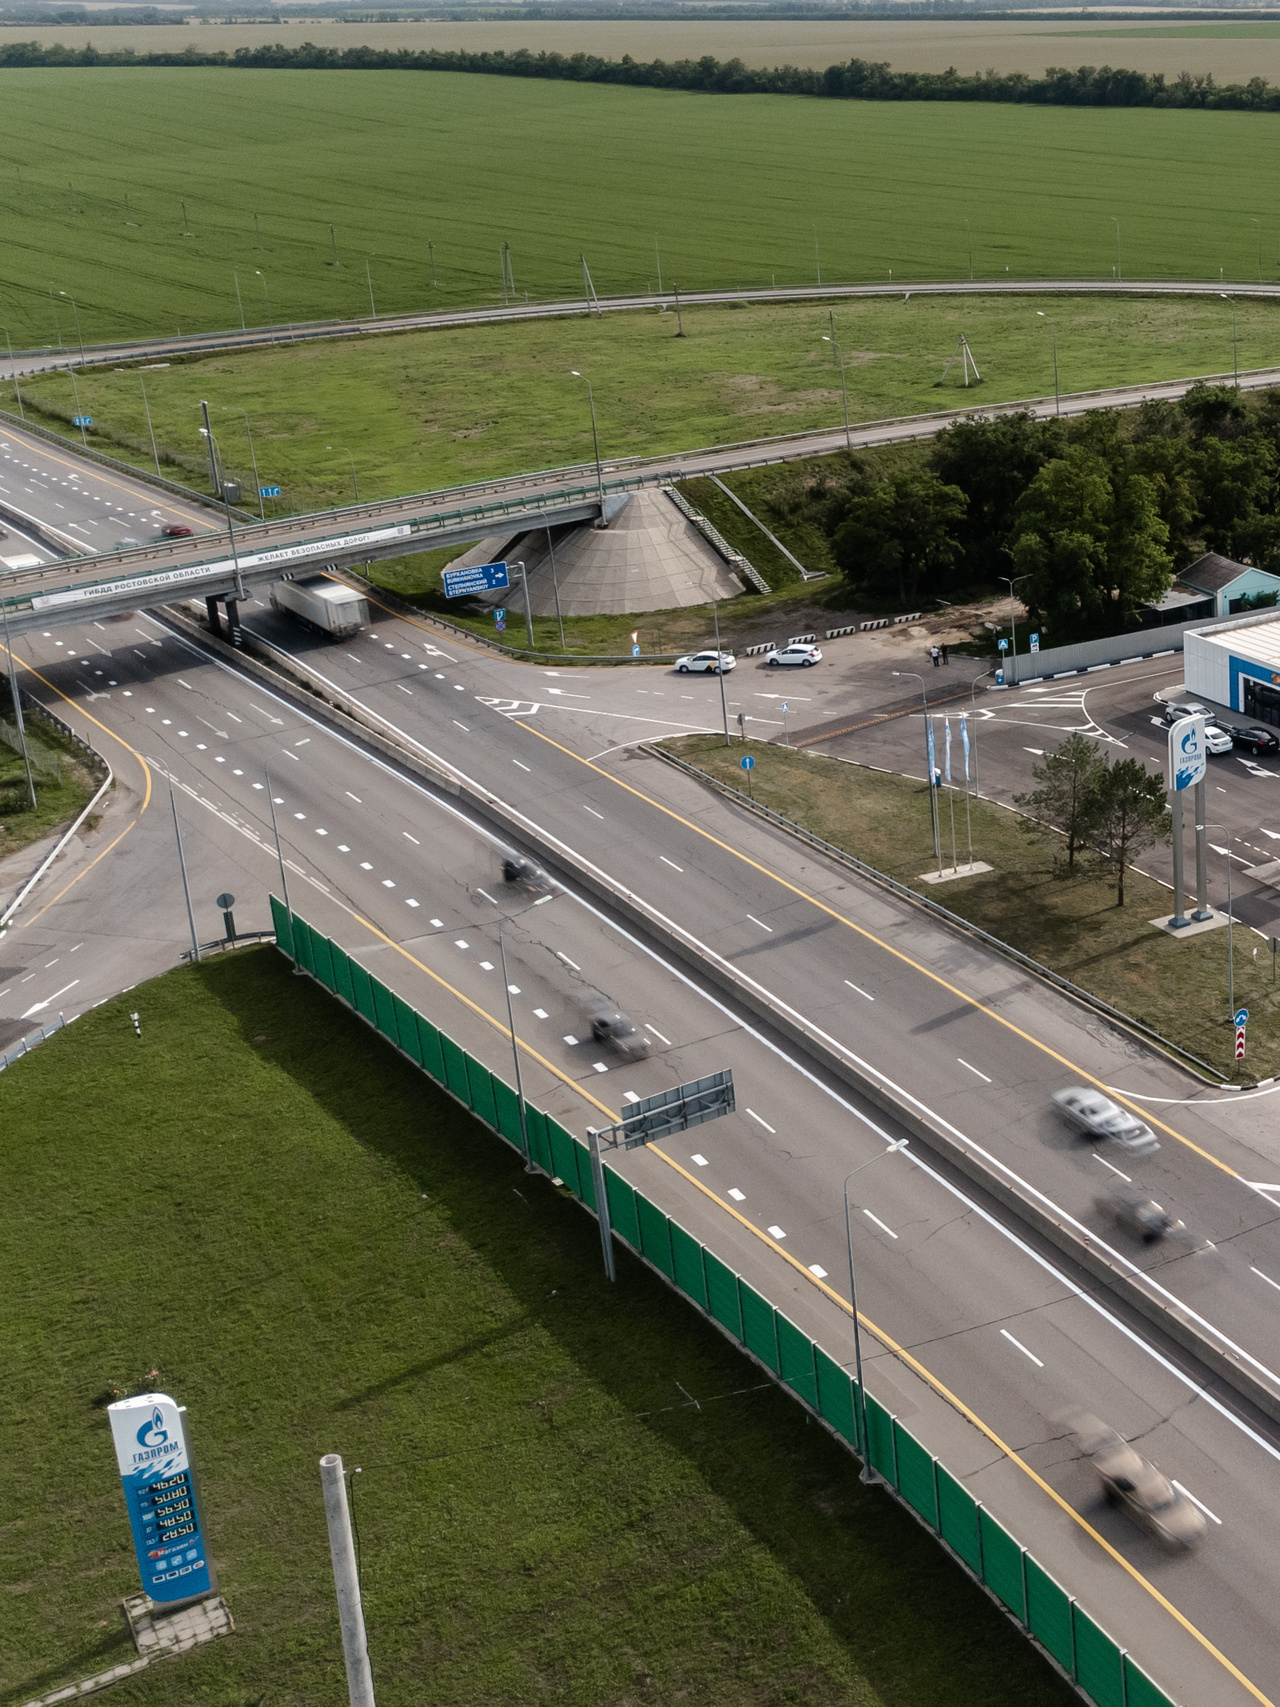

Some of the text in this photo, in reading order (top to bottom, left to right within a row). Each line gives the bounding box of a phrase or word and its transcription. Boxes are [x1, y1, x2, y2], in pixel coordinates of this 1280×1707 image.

[257, 535, 370, 562] ЖЕЛАЕТ БЕЗОПАСНЫХ ДОРОГ!
[84, 567, 211, 596] ГИБДД РОСТОВСКОЙ ОБЛАСТИ
[1179, 753, 1202, 765] ГАЗПРОМ
[132, 1440, 179, 1464] ГАЗПРОМ
